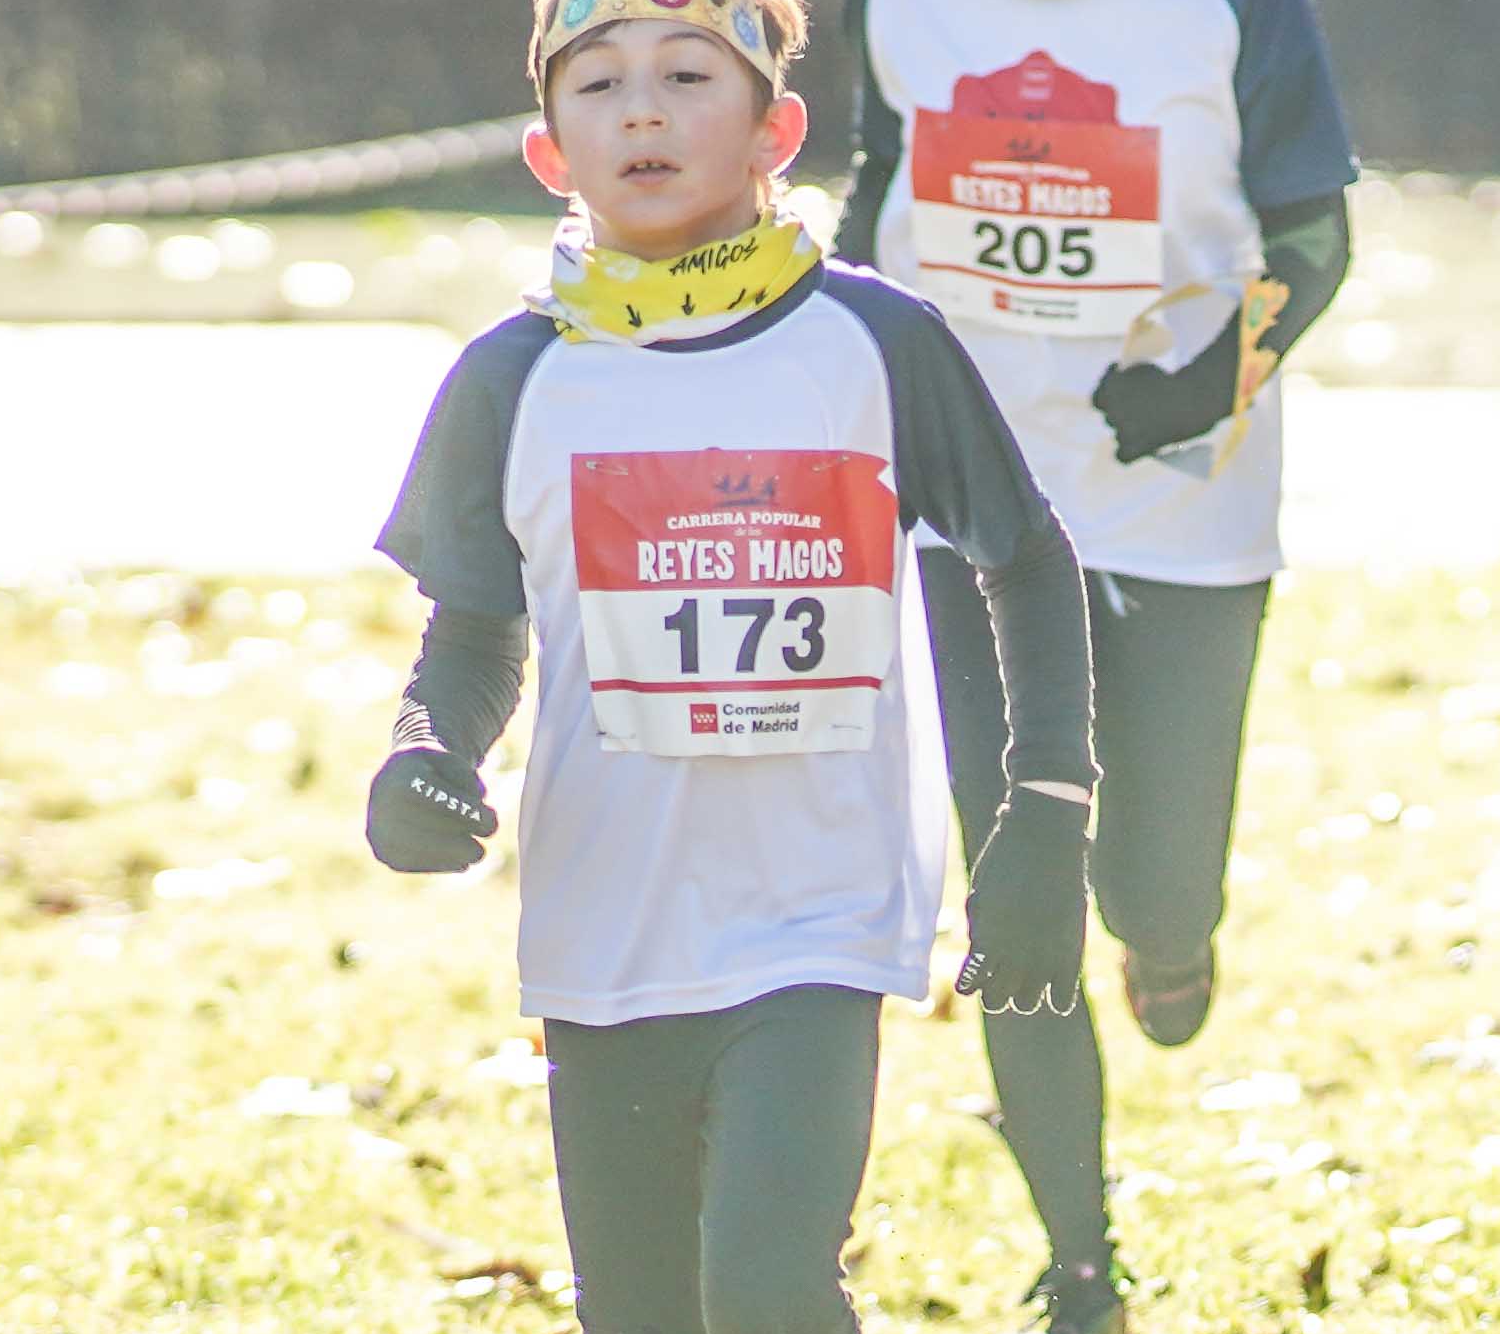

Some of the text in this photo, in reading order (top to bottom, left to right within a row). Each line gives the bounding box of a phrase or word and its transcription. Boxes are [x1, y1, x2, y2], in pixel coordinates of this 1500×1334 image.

[669, 236, 759, 276] AMIGOS
[974, 220, 1094, 277] 205
[667, 512, 821, 529] CARRERA POPULAR
[637, 538, 844, 582] REYES MAGOS
[664, 597, 825, 675] 173
[723, 701, 800, 715] Comunidad
[724, 718, 799, 734] de Madrid
[410, 777, 481, 821] KIPSTA
